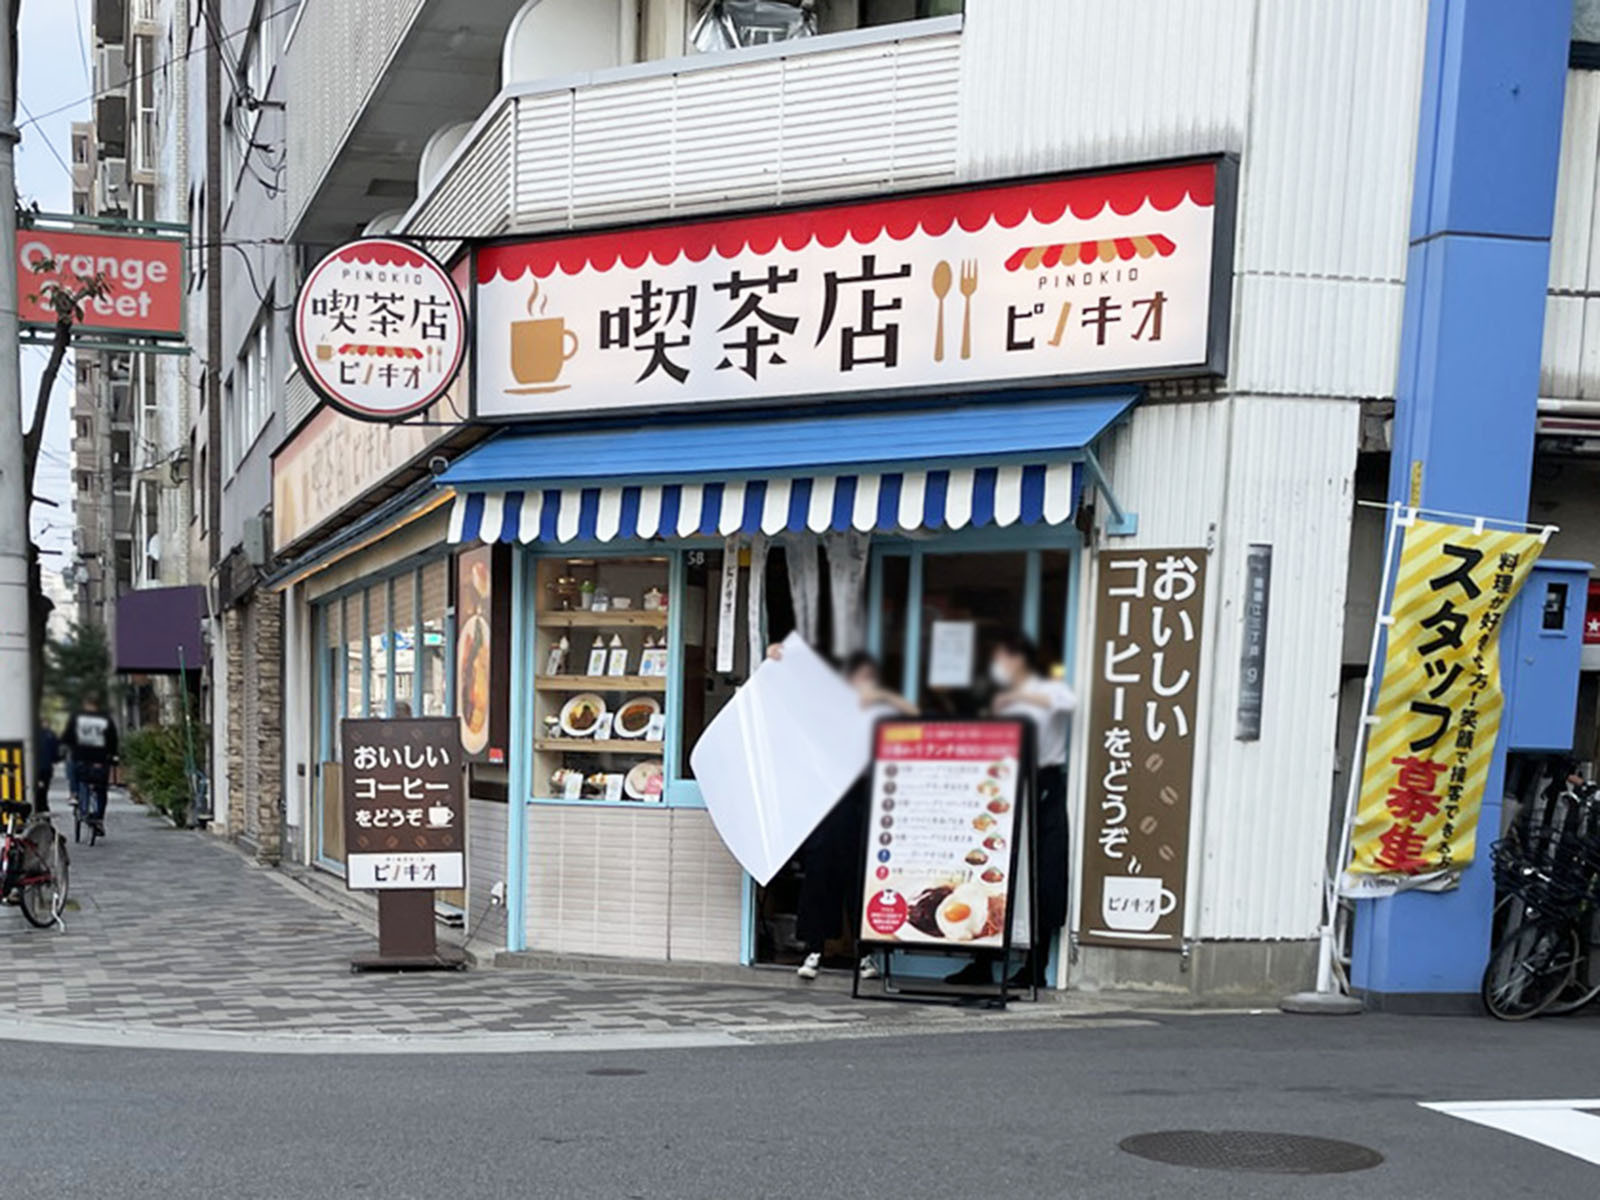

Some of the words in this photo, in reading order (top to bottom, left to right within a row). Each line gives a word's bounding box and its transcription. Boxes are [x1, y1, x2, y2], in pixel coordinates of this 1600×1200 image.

[20, 242, 168, 289] Orange
[342, 269, 422, 285] PINOKIO
[1038, 268, 1139, 290] PINOKIO
[312, 289, 451, 340] 喫茶店
[599, 255, 911, 385] 喫茶店
[1006, 291, 1168, 351] ピノキオ
[340, 361, 422, 389] ピノキオ
[1147, 556, 1198, 741] おいしい
[1099, 557, 1148, 858] コーヒーをどうぞ
[354, 746, 450, 770] おいしい
[355, 777, 449, 799] コーヒー
[355, 808, 423, 827] をどうぞ
[374, 864, 436, 881] ピノキオ
[1109, 897, 1155, 914] ピノキオ
